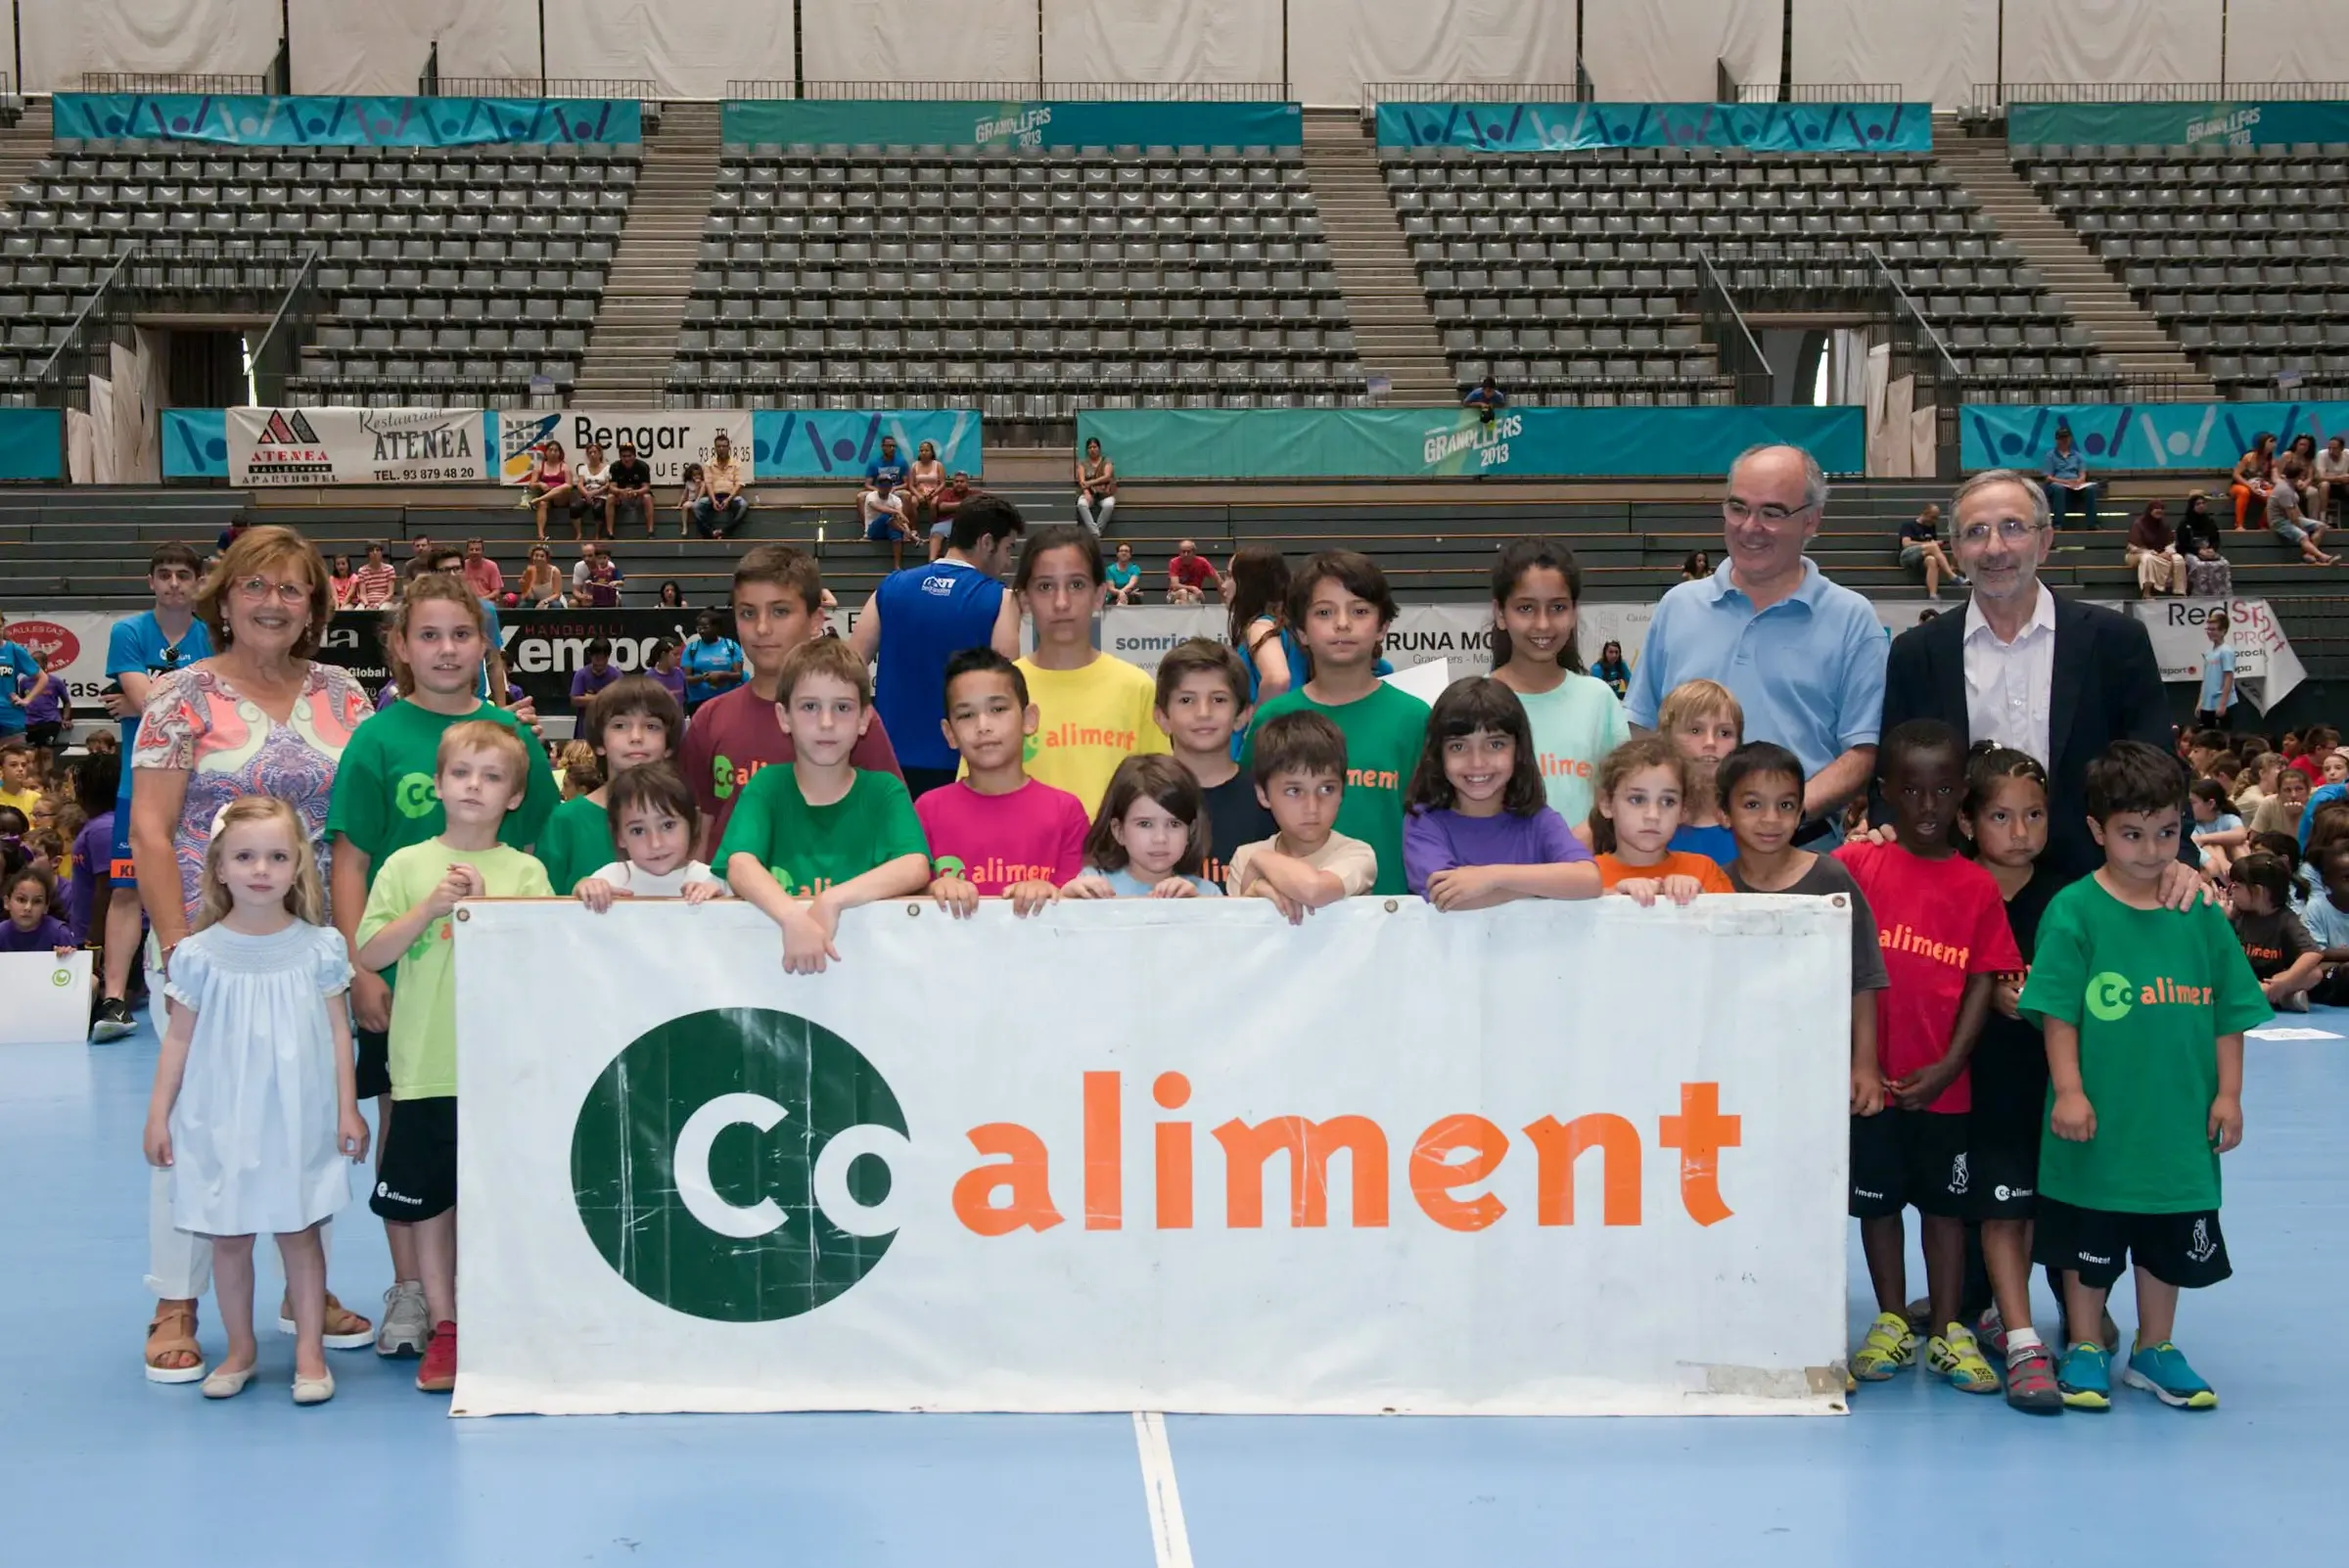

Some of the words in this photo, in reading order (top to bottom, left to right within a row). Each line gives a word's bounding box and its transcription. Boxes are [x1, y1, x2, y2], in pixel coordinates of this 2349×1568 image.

[374, 429, 473, 461] ATENEA
[575, 417, 690, 459] Bengar
[251, 450, 329, 462] ATENEA
[698, 446, 709, 462] 93
[740, 446, 751, 461] 35
[1481, 442, 1509, 467] 2013
[242, 475, 340, 485] APARTHOTEL
[374, 471, 399, 482] TEL.
[403, 470, 417, 481] 93
[420, 469, 440, 480] 879
[443, 468, 458, 479] 48
[460, 467, 474, 479] 20
[319, 623, 359, 649] la
[1386, 631, 1454, 651] RUNA
[348, 668, 387, 678] Global
[1045, 723, 1136, 751] aliment
[1346, 768, 1399, 790] ment
[1878, 924, 1970, 970] aliment
[2099, 984, 2134, 1007] Co
[673, 1092, 916, 1238] Co
[951, 1071, 1742, 1235] aliment
[1855, 1187, 1884, 1200] iment
